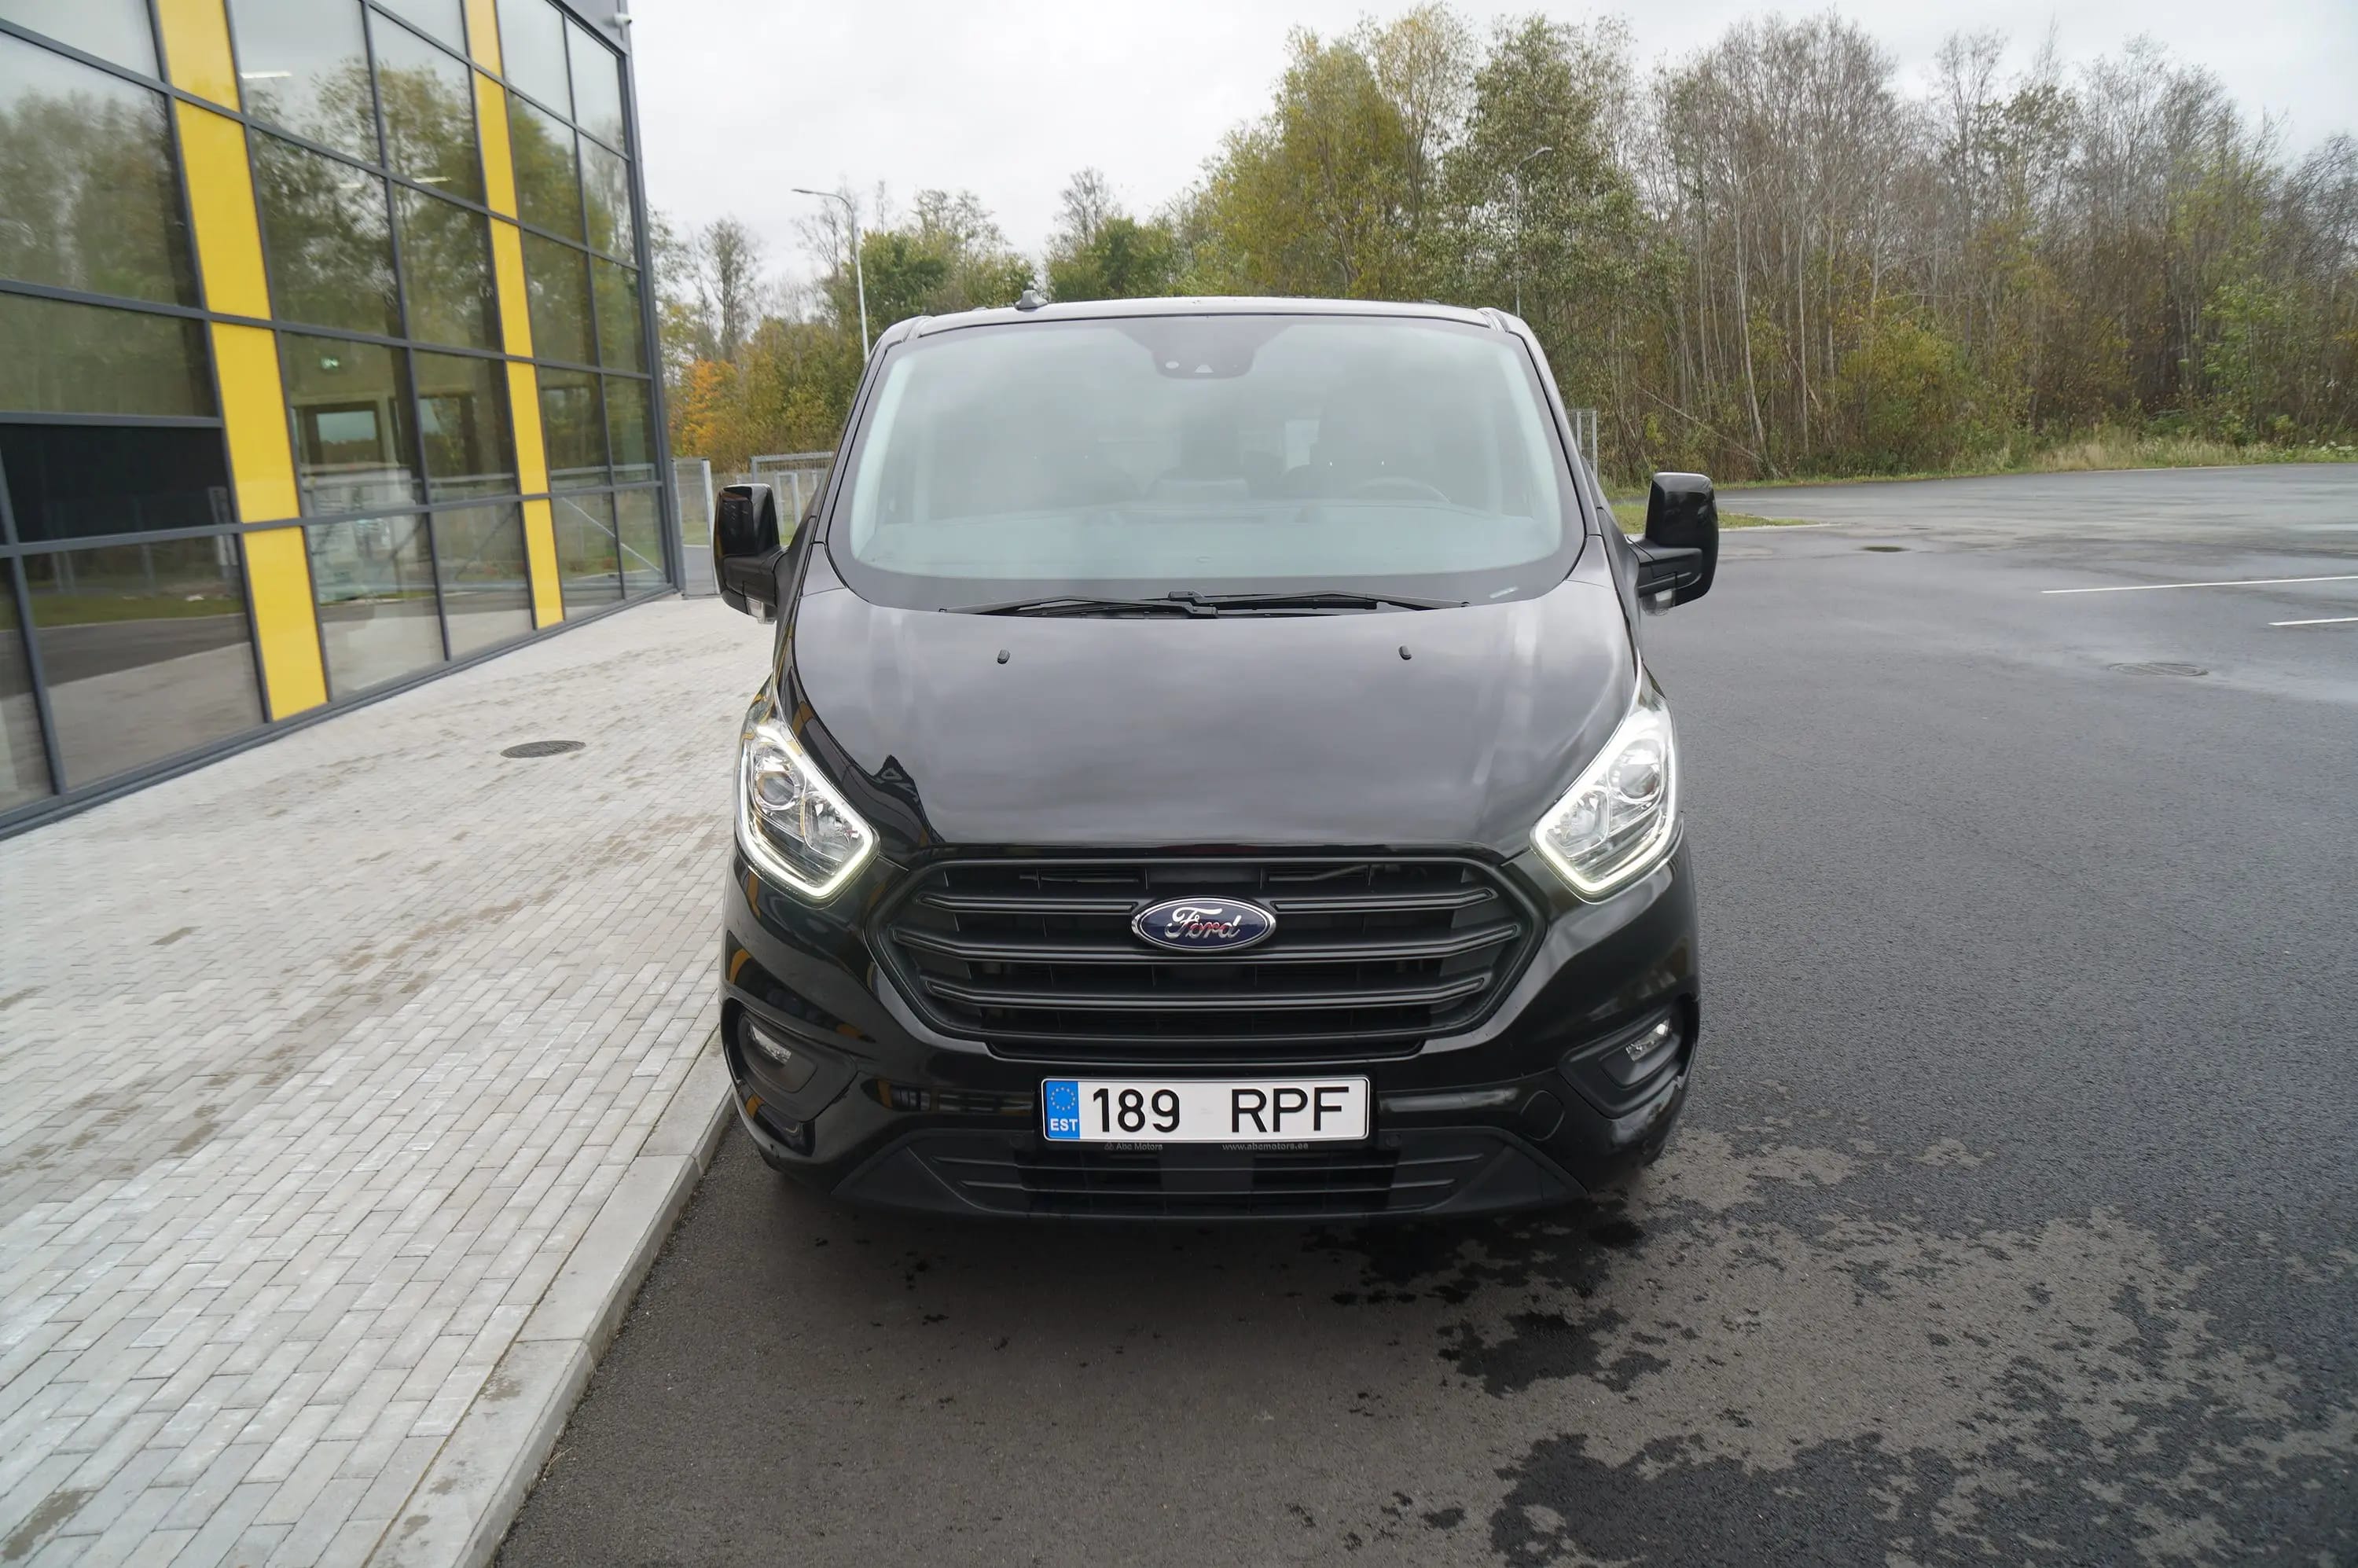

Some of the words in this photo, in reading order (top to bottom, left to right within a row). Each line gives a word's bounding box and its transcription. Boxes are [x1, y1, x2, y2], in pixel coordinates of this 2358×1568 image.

[1164, 906, 1242, 939] Ford
[1093, 1088, 1180, 1133] 189
[1231, 1086, 1350, 1133] RPF
[1050, 1118, 1078, 1132] EST
[1134, 1143, 1163, 1151] Motors
